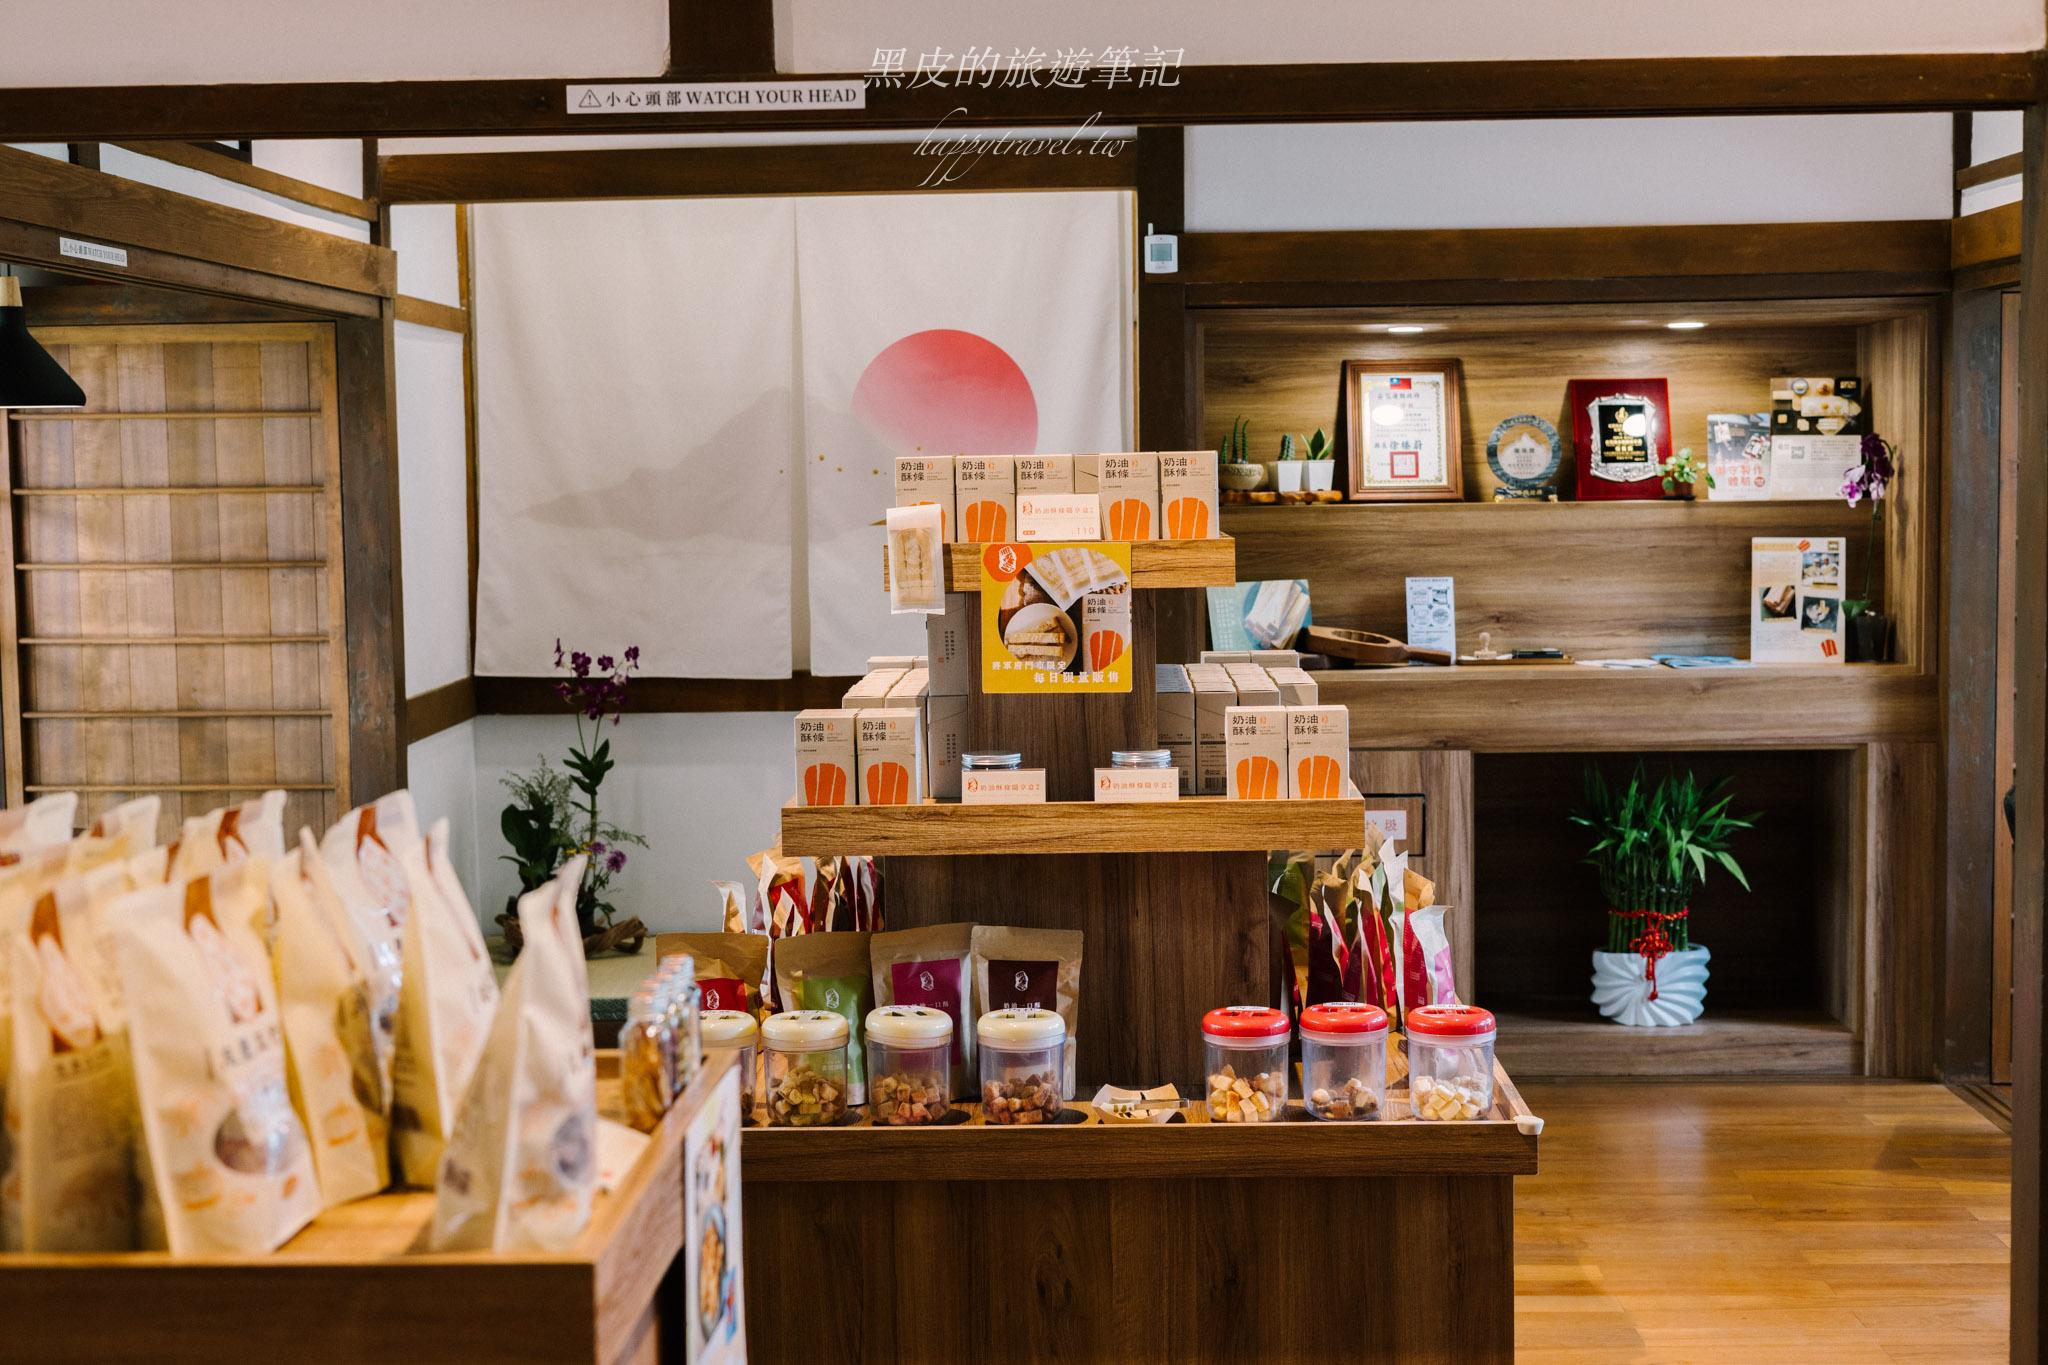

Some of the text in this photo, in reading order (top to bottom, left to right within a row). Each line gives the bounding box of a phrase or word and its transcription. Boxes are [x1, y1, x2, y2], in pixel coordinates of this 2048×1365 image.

[606, 88, 857, 107] 小心頭部 WATCH YOUR HEAD
[901, 461, 924, 470] 奶油
[962, 461, 986, 470] 奶油
[1020, 459, 1045, 470] 奶油
[1105, 458, 1129, 468] 奶油
[1163, 458, 1188, 467] 奶油
[1034, 672, 1119, 684] 每日限量販售
[1232, 715, 1257, 724] 奶油
[1294, 714, 1319, 724] 奶油
[800, 722, 825, 732] 奶油
[862, 721, 887, 730] 奶油
